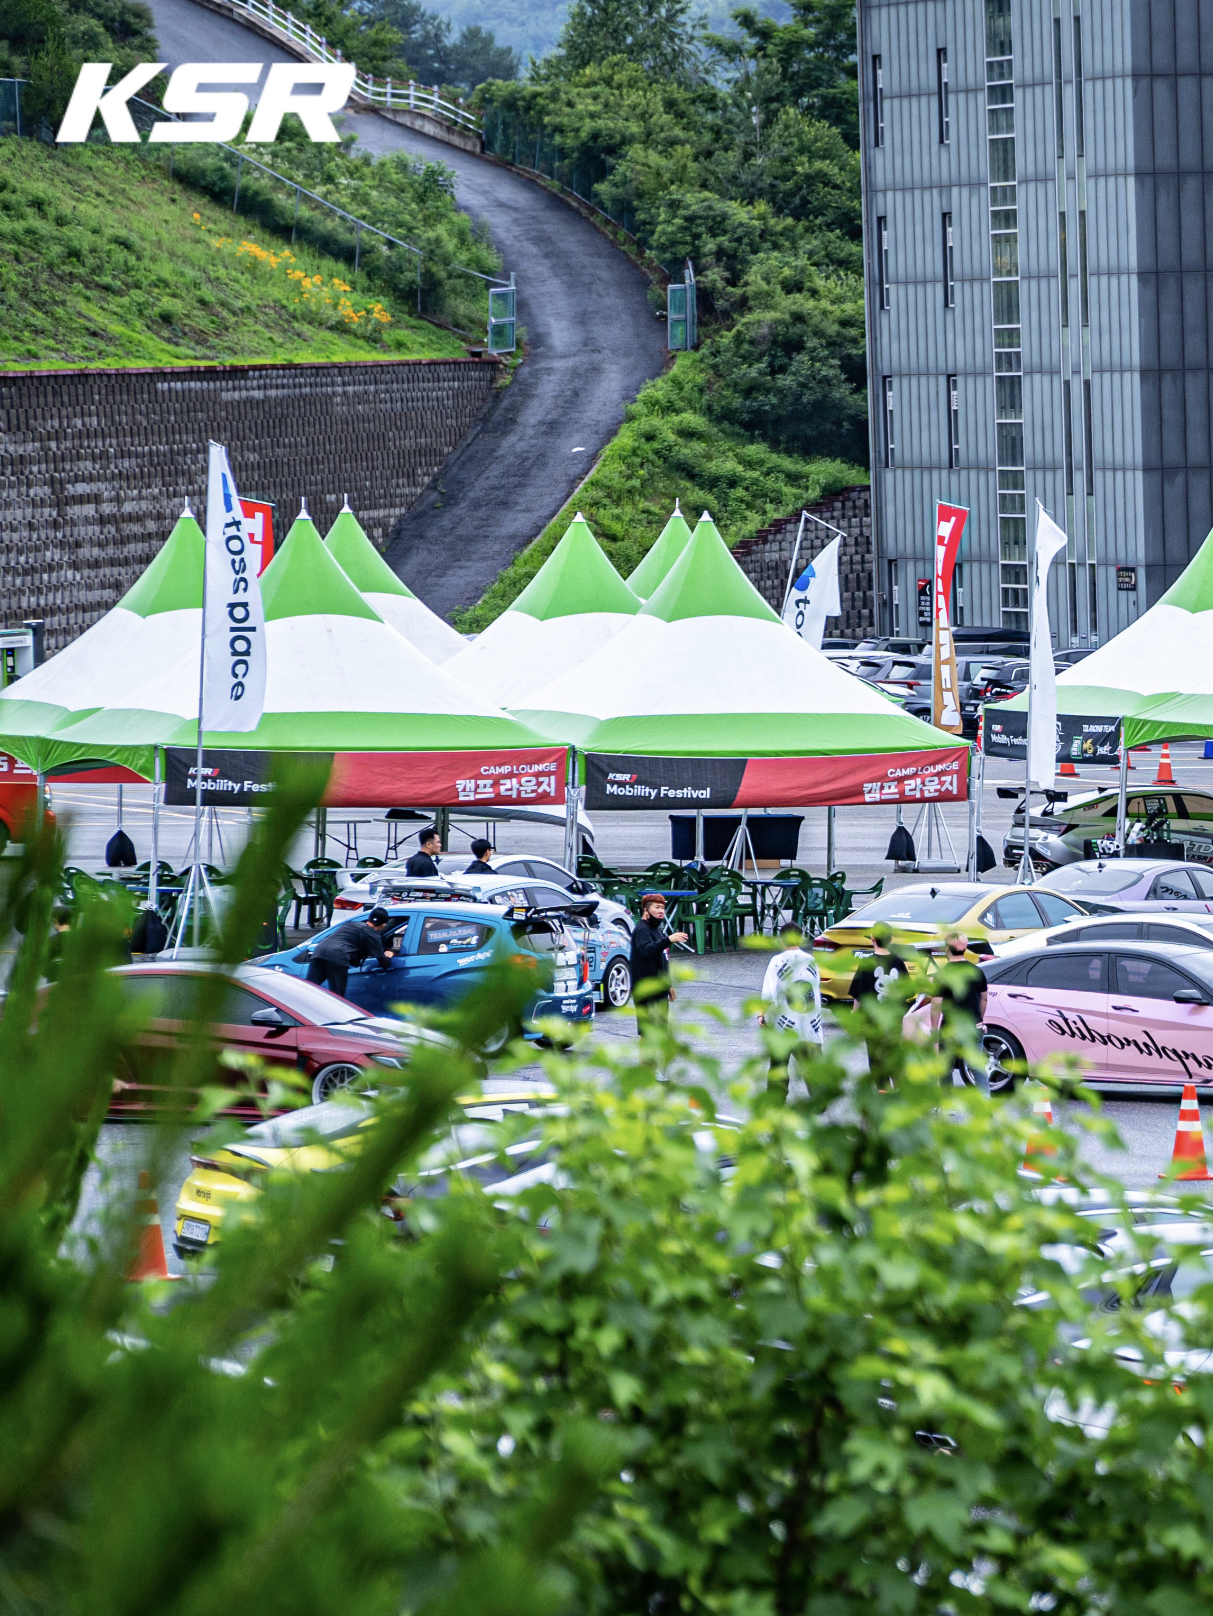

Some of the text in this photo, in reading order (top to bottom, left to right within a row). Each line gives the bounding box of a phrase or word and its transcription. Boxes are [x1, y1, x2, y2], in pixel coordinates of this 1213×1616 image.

[224, 516, 249, 594] toss
[227, 602, 257, 702] place
[480, 762, 557, 776] CAMP LOUNGE
[887, 762, 959, 778] CAMP LOUNGE
[187, 778, 241, 793] Mobility
[607, 773, 631, 782] KSR
[455, 775, 556, 801] 캠프 라운지
[606, 783, 711, 799] Mobility Festival
[863, 775, 958, 802] 캠프 라운지
